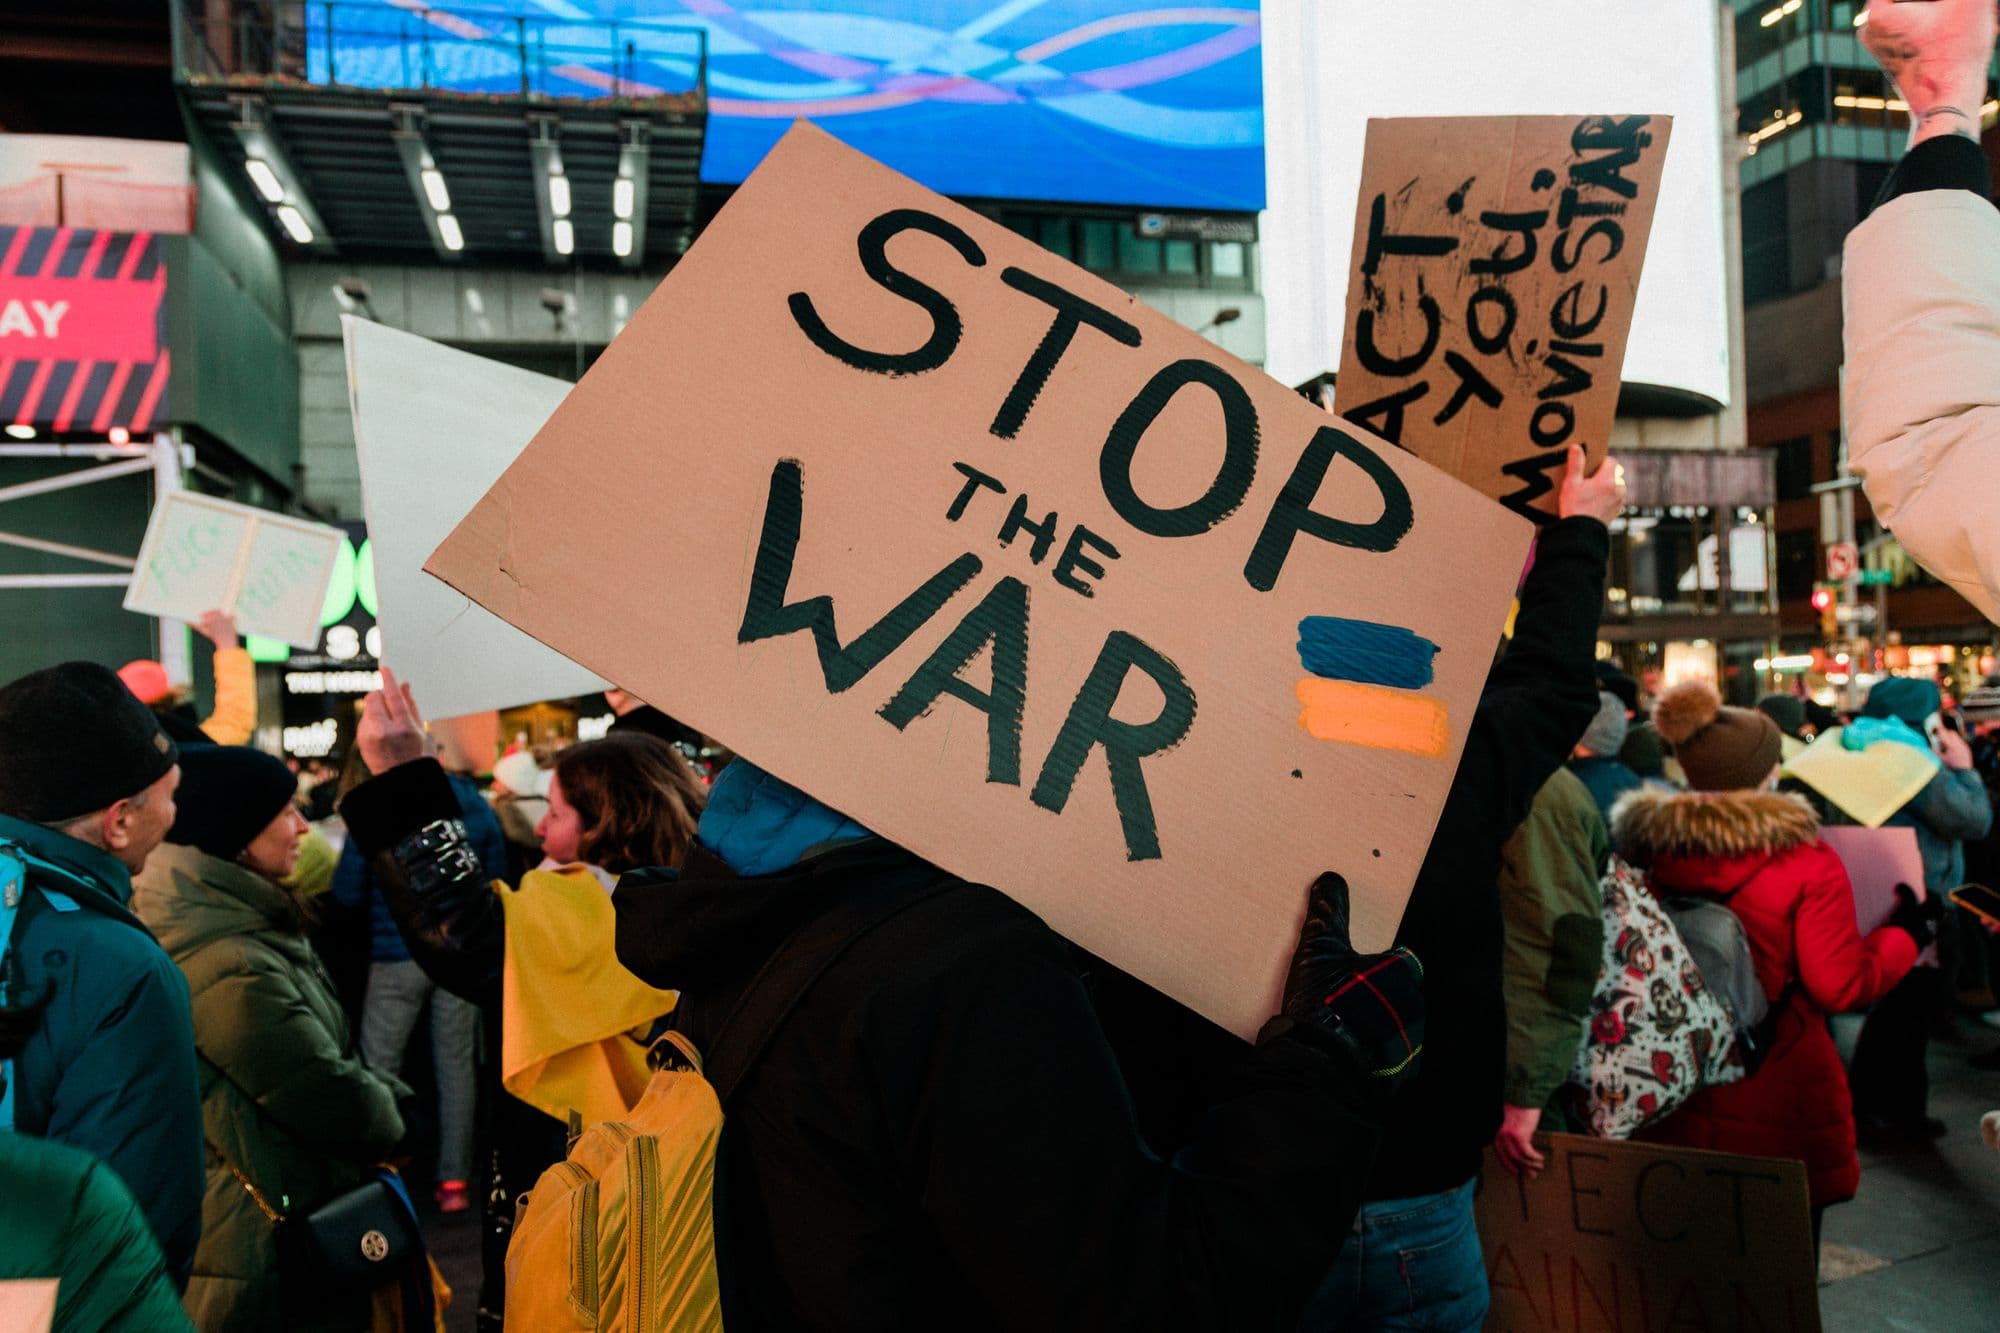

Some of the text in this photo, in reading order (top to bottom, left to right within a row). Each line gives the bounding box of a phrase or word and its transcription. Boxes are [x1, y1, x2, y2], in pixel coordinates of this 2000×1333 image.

[787, 209, 1414, 592] STOP
[952, 462, 1121, 598] THE
[737, 458, 1198, 862] WAR
